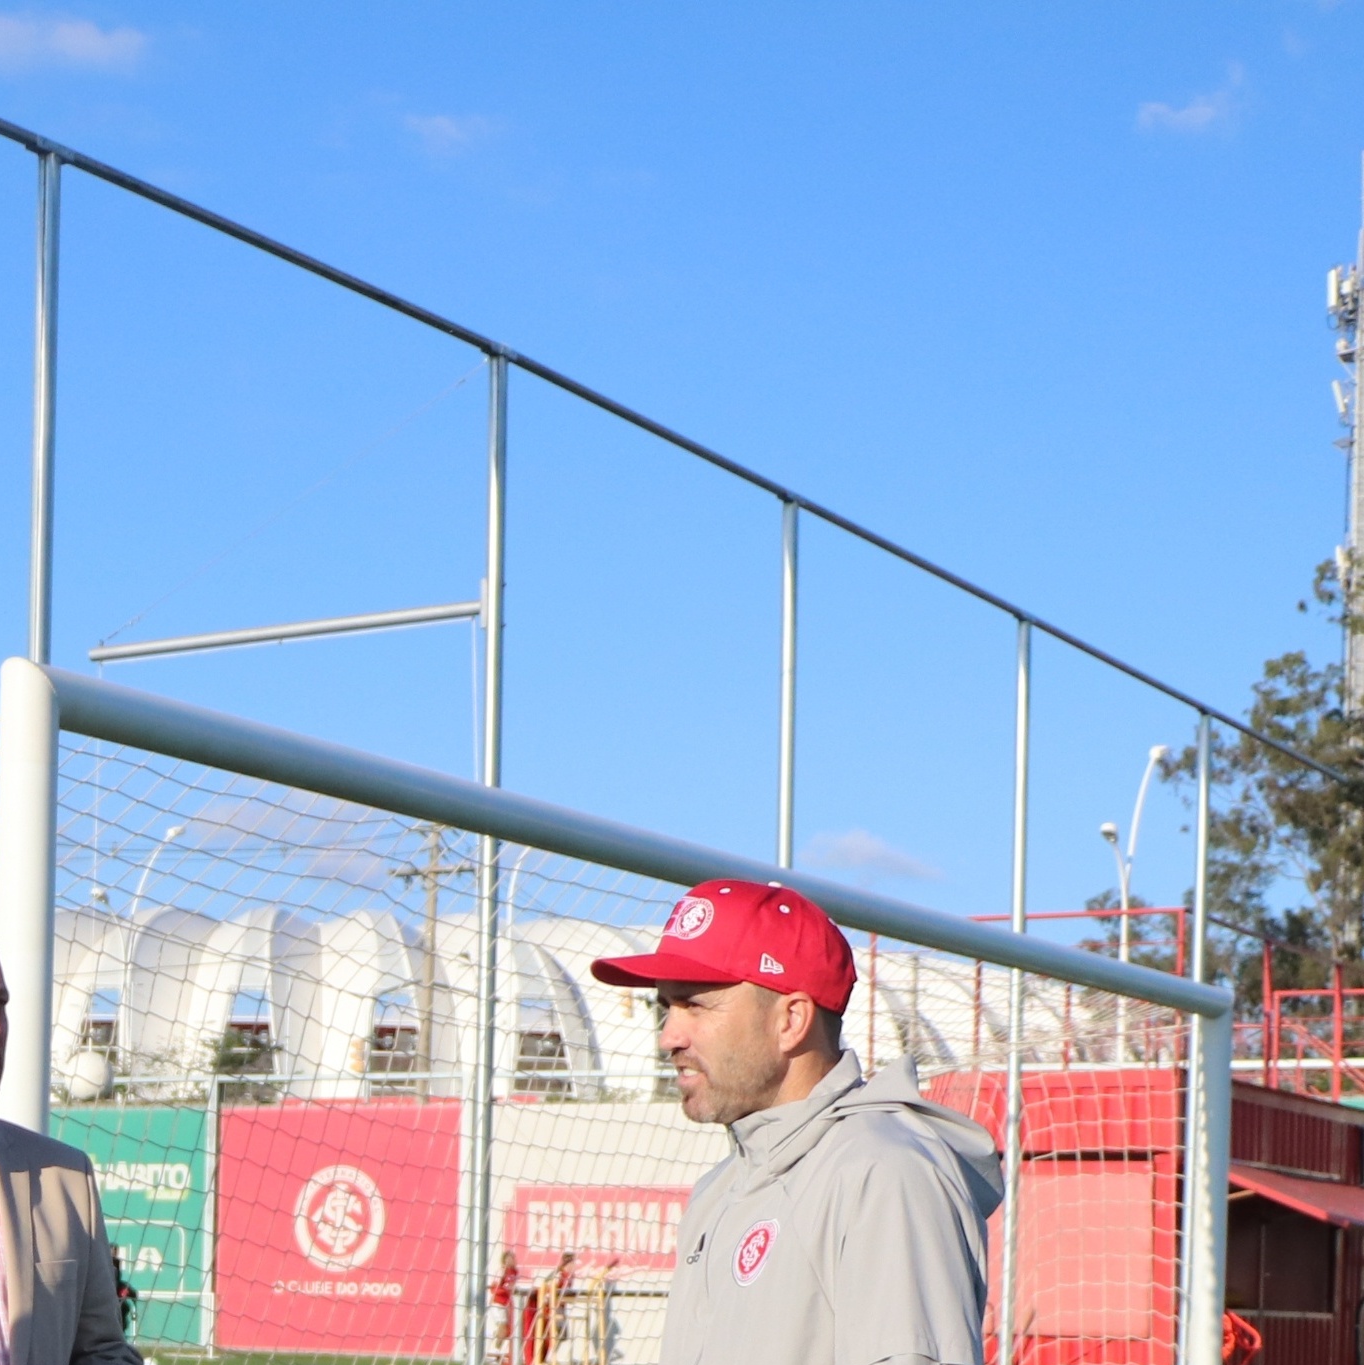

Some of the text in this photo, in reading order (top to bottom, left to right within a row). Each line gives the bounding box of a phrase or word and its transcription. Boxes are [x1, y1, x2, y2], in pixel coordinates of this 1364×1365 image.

[527, 1200, 683, 1254] BRAHMA
[287, 1280, 333, 1295] CLUBE
[336, 1281, 359, 1295] DO
[361, 1282, 403, 1297] POVO
